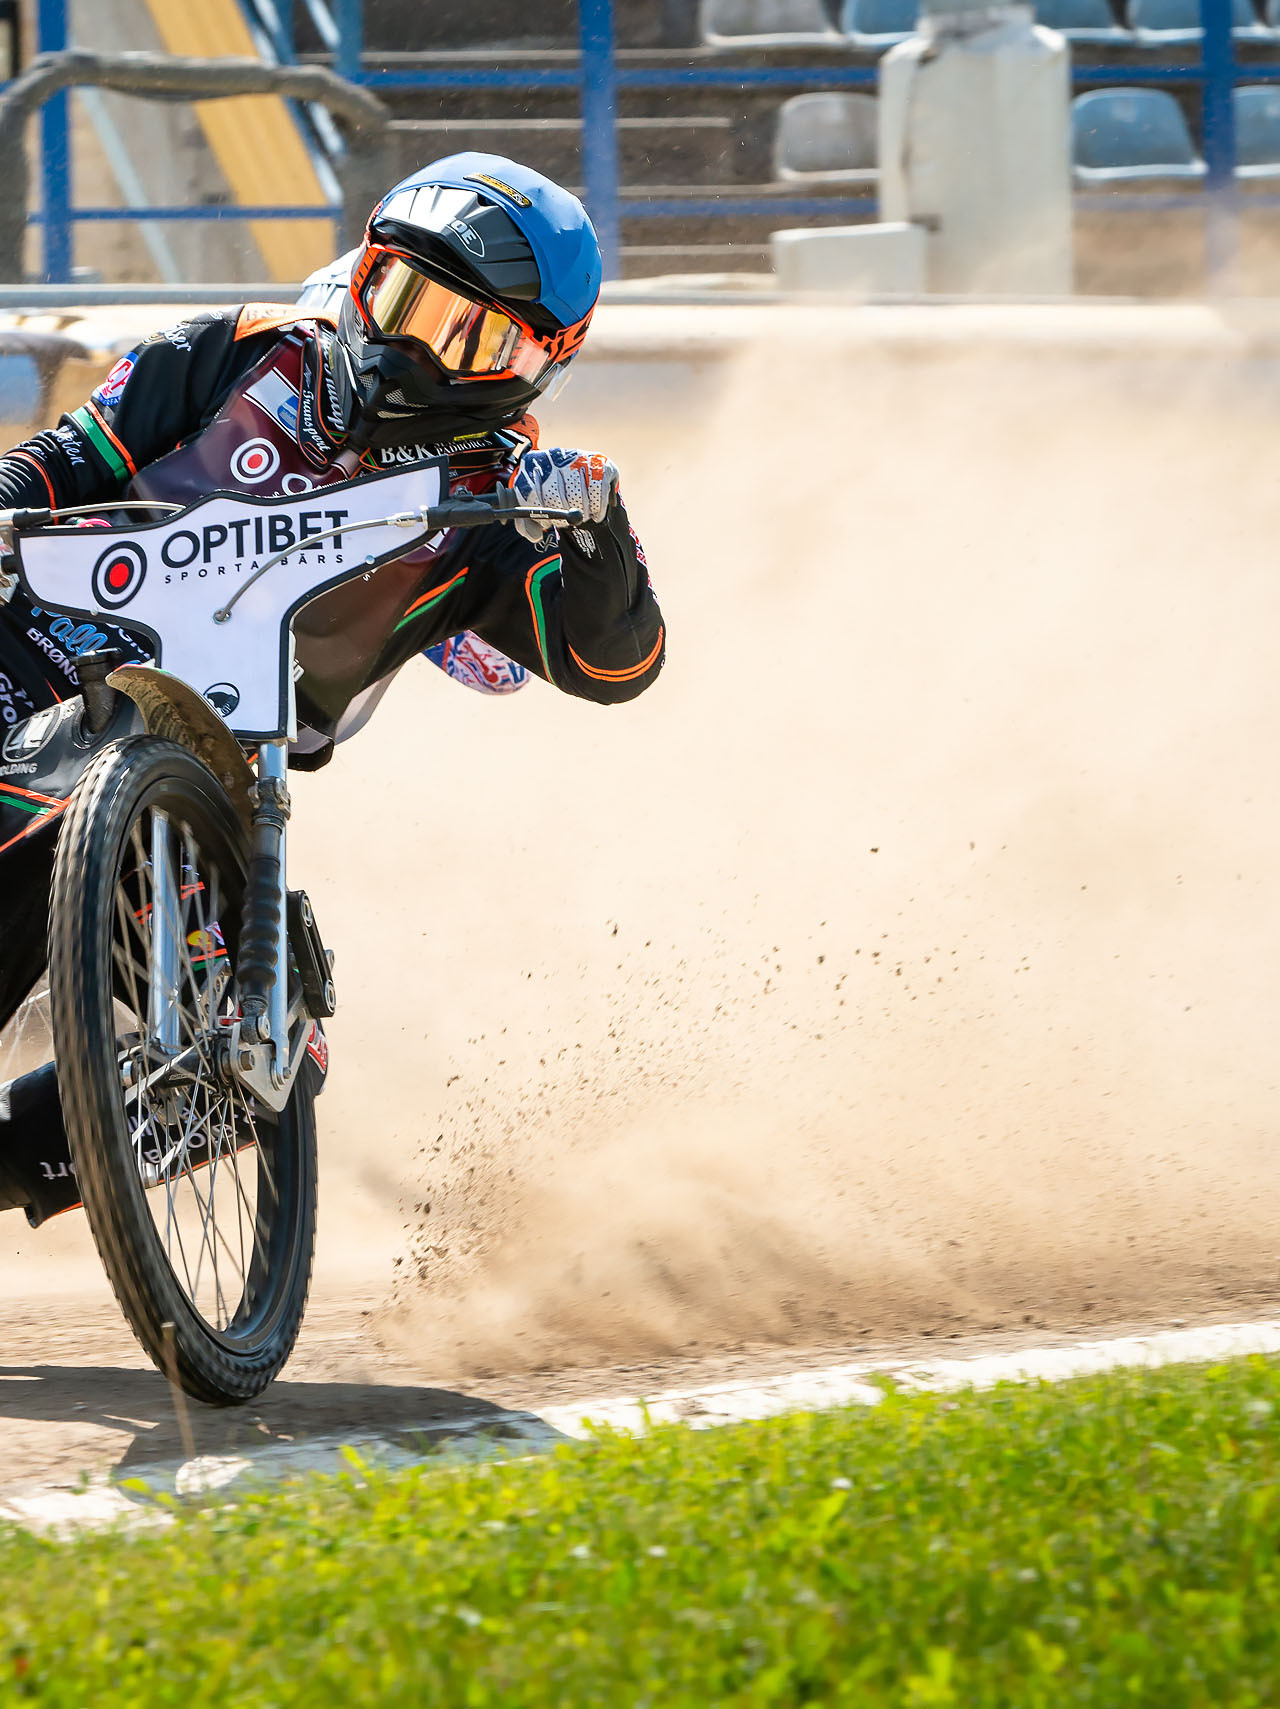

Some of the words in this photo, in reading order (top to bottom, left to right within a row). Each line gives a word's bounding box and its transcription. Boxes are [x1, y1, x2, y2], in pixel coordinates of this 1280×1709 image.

[302, 388, 331, 451] Transport
[161, 510, 348, 568] OPTIBET
[165, 561, 259, 583] SPORTA
